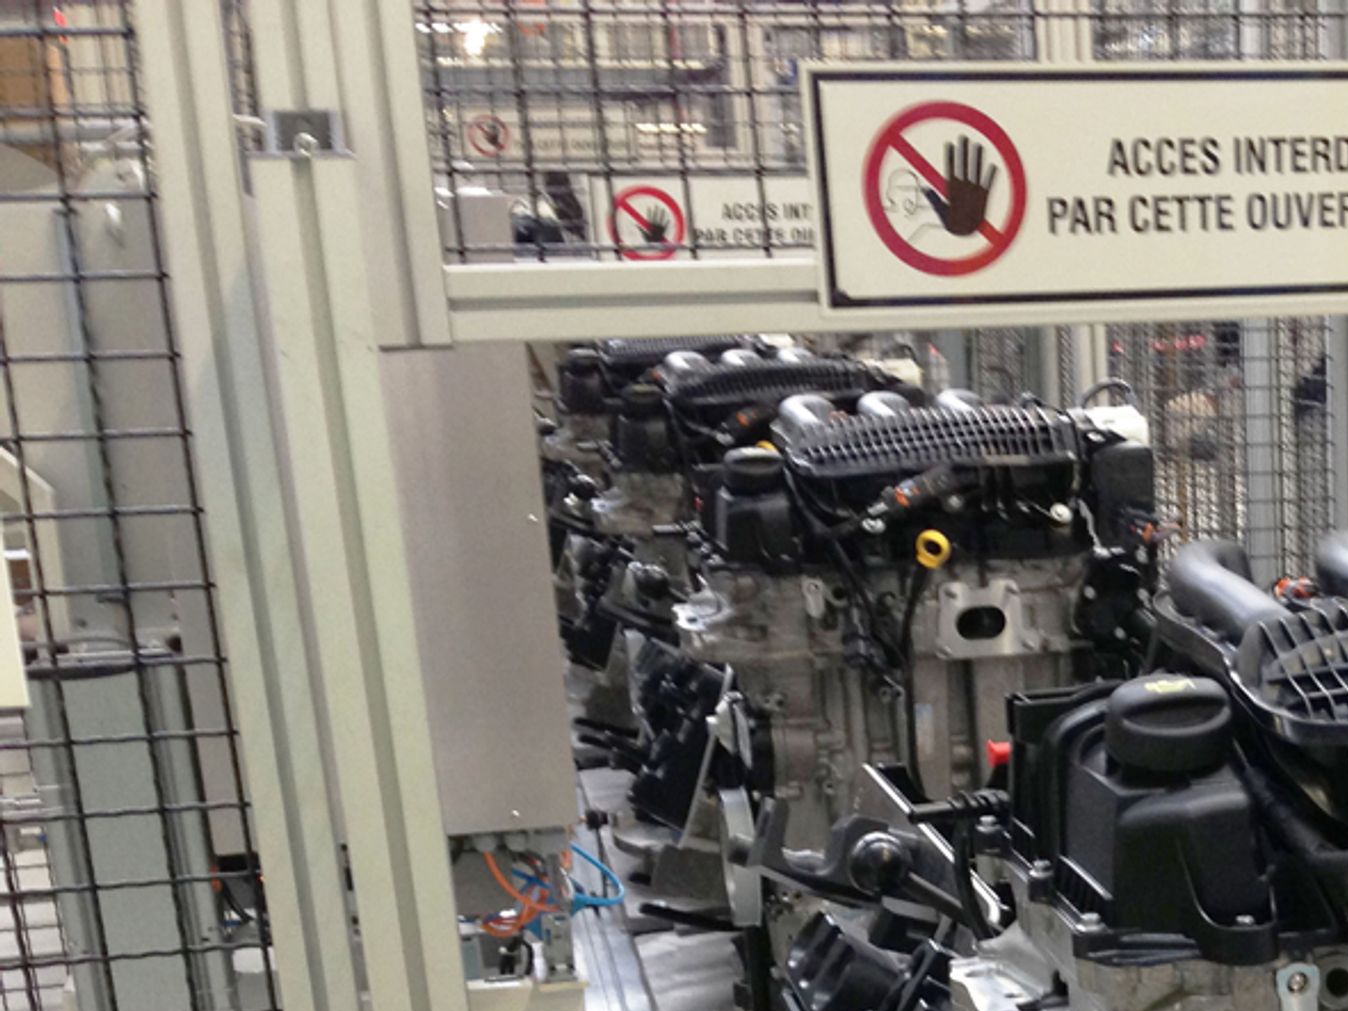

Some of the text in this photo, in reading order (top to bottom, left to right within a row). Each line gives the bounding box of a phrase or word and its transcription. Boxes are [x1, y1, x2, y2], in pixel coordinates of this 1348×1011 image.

[1107, 137, 1221, 176] ACCES
[721, 202, 779, 221] ACCS
[1046, 195, 1118, 235] PAR
[1127, 193, 1236, 234] CETTE
